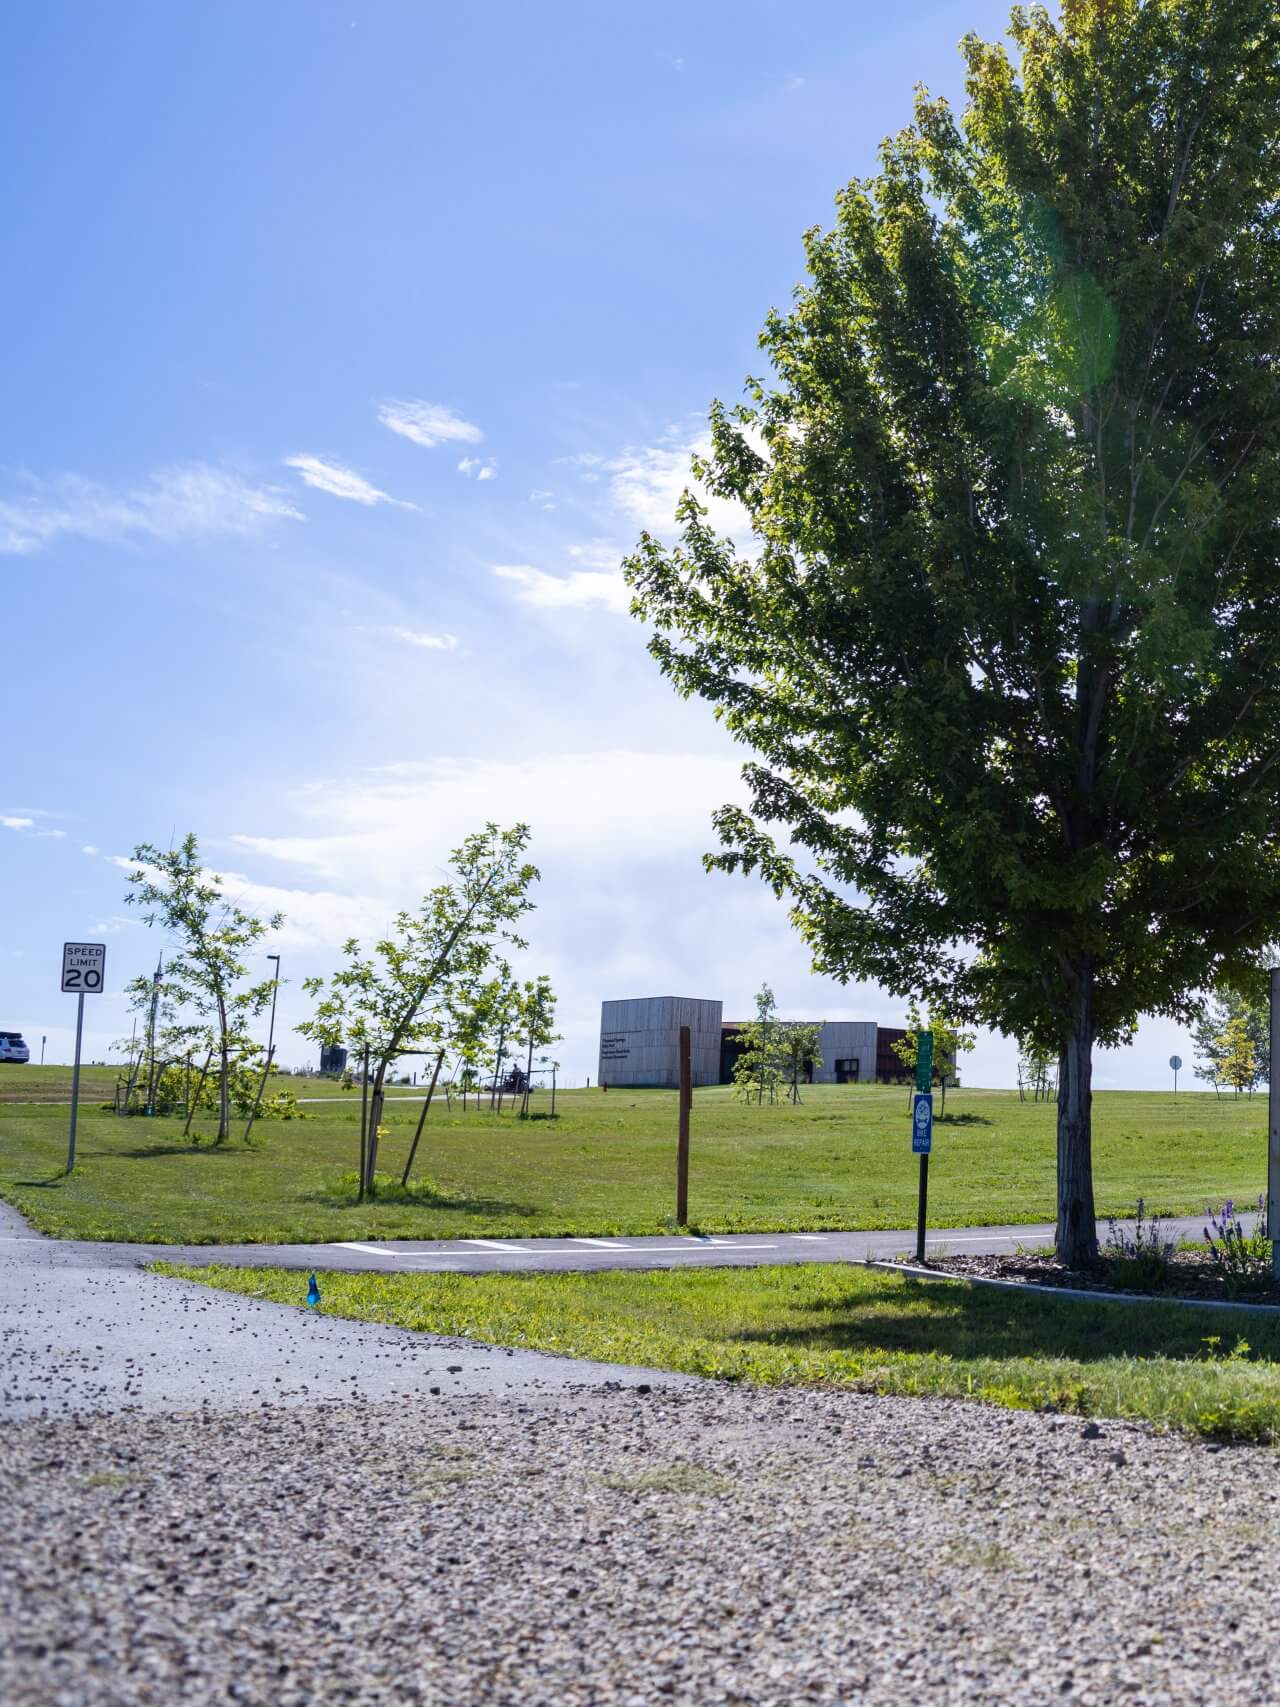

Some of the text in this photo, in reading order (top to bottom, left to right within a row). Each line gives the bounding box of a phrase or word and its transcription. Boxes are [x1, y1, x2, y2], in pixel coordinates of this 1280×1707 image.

[67, 947, 103, 956] SPEED
[70, 958, 97, 966] LIMIT
[65, 969, 100, 987] 20
